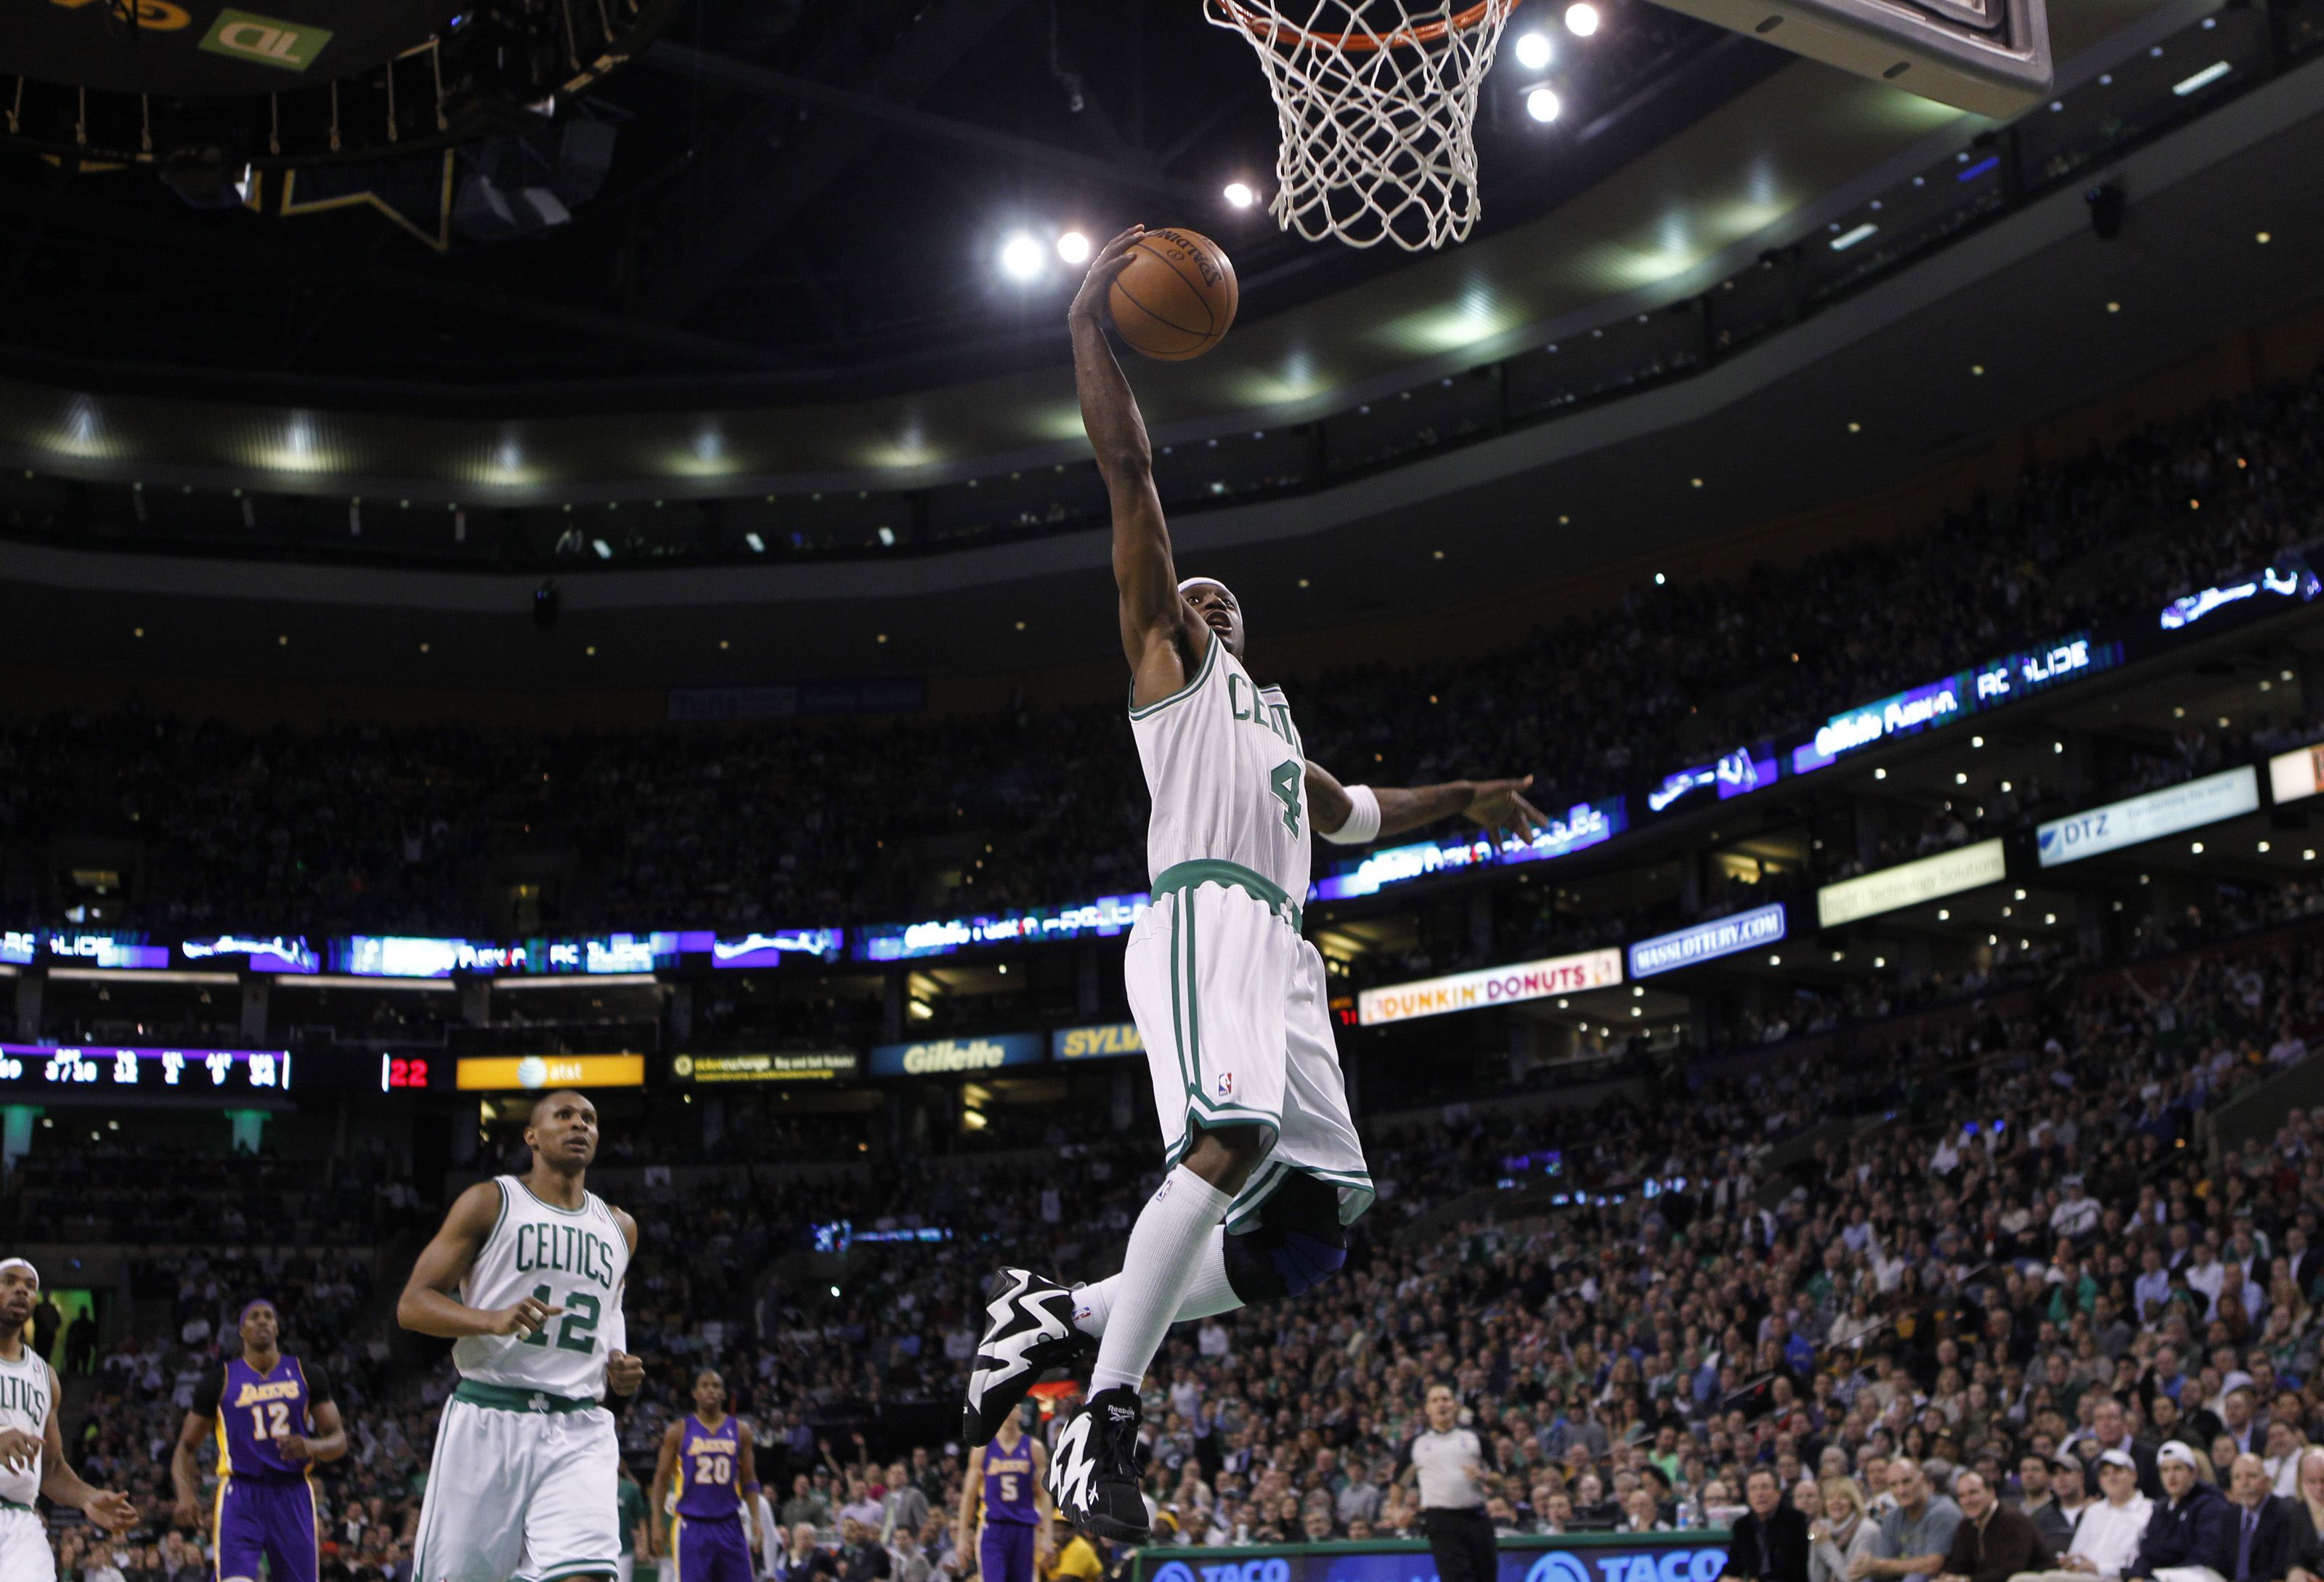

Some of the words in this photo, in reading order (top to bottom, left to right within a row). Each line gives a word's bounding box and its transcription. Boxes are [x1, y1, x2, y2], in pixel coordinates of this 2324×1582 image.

[219, 21, 301, 63] TD
[1229, 672, 1306, 762] CELTI
[1271, 759, 1302, 839] 4
[2065, 814, 2110, 846] DTZ
[1384, 982, 1484, 1018] DUNKIN'
[1487, 964, 1586, 1000] DONUTS
[389, 1059, 428, 1088] 22
[903, 1039, 1005, 1075] Gillette
[516, 1223, 614, 1289] CELTICS
[520, 1284, 601, 1355] 12
[0, 1375, 45, 1427] LTICS
[250, 1401, 290, 1441] 12
[695, 1454, 731, 1485] 20
[1000, 1475, 1019, 1502] 5
[1199, 1558, 1291, 1582] TACO
[1596, 1549, 1728, 1582] TACO
